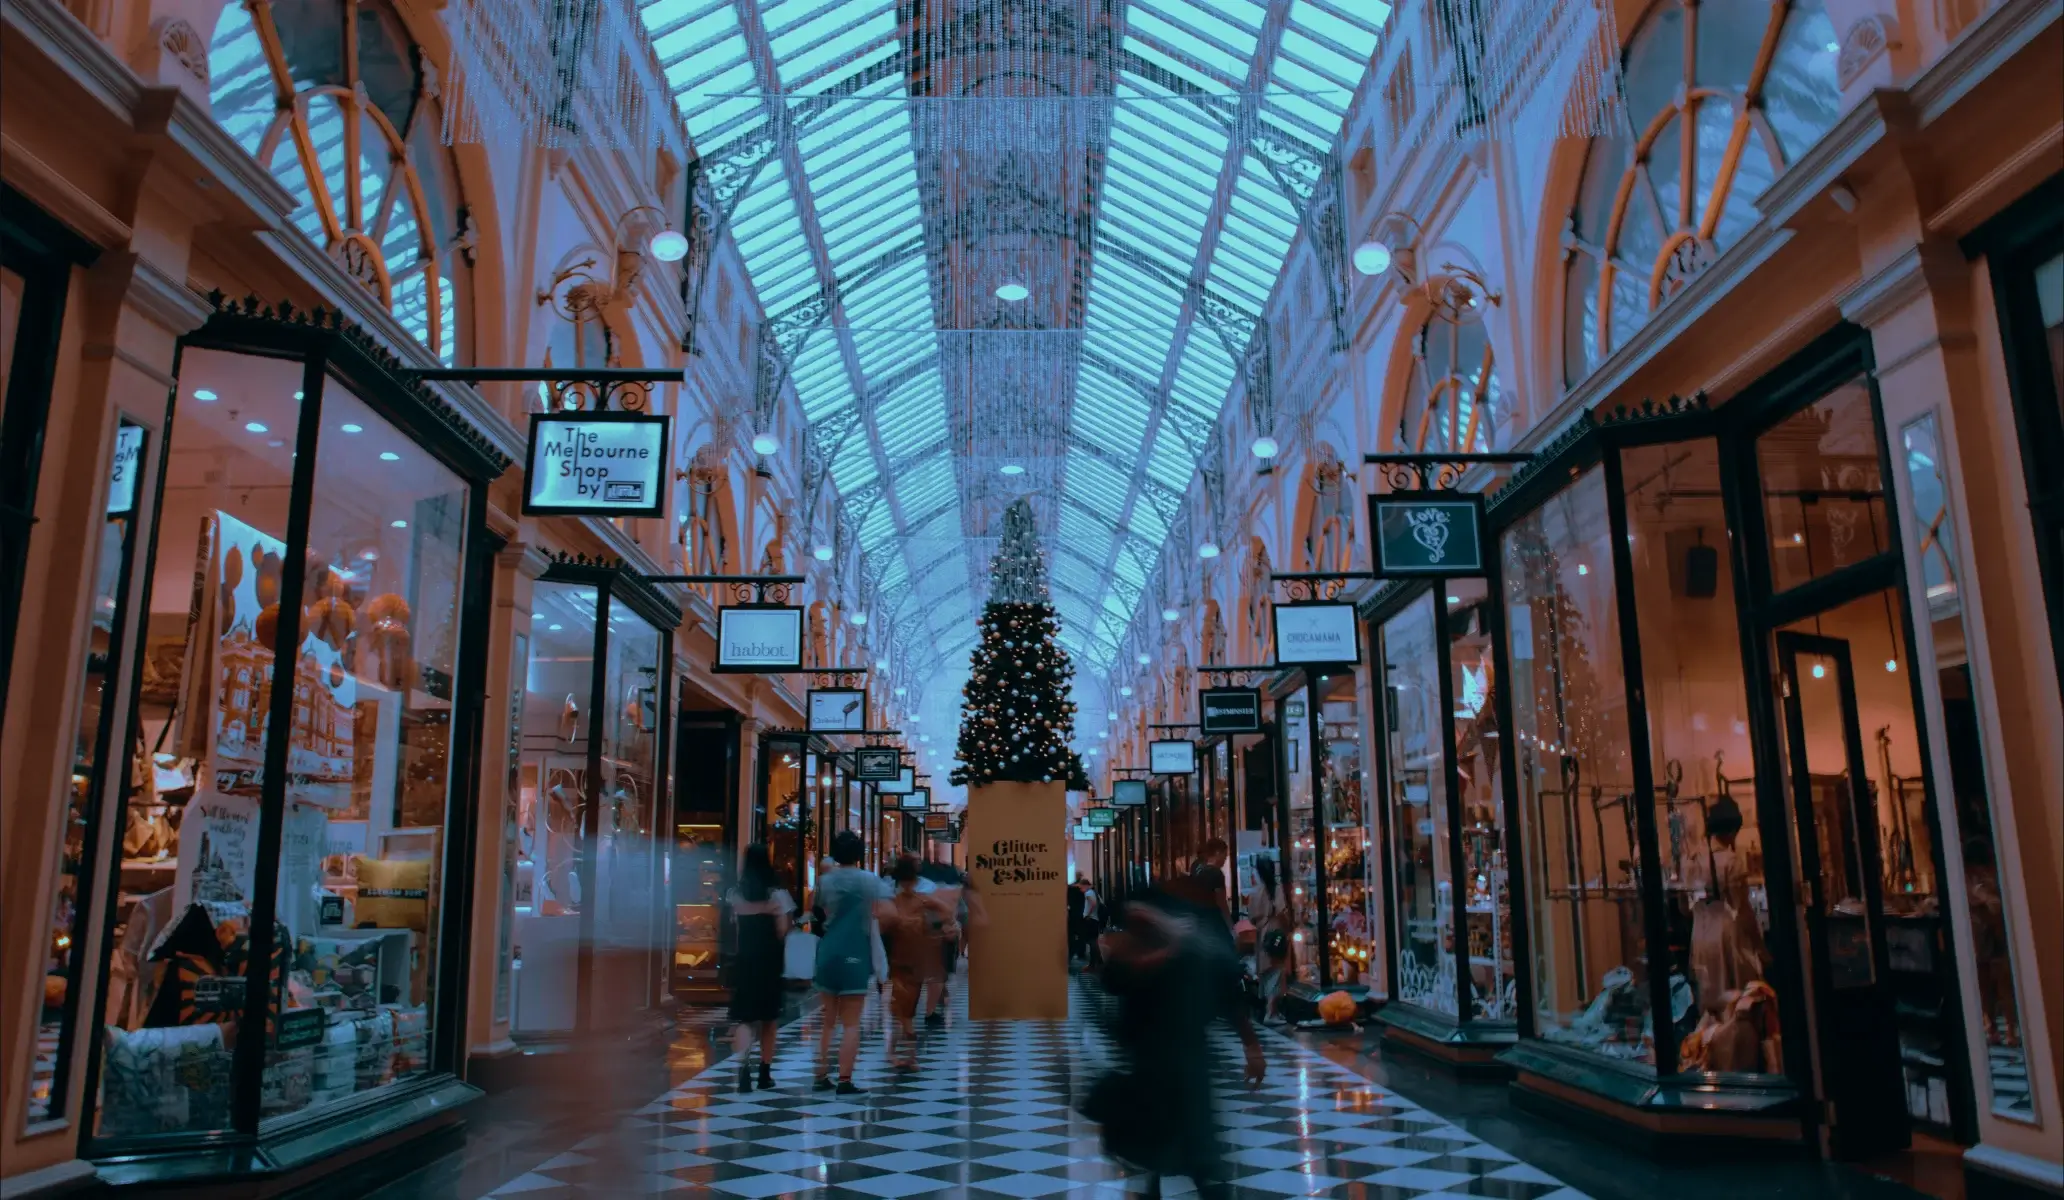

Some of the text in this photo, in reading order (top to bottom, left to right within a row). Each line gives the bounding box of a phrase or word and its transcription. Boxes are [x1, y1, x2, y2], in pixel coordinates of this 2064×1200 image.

[565, 427, 598, 444] The
[544, 441, 649, 459] Melbourne
[560, 460, 609, 481] Shop
[578, 480, 600, 498] by
[731, 642, 788, 657] habbot.
[1206, 706, 1254, 717] STMINSTER
[975, 853, 1036, 870] Sparkle
